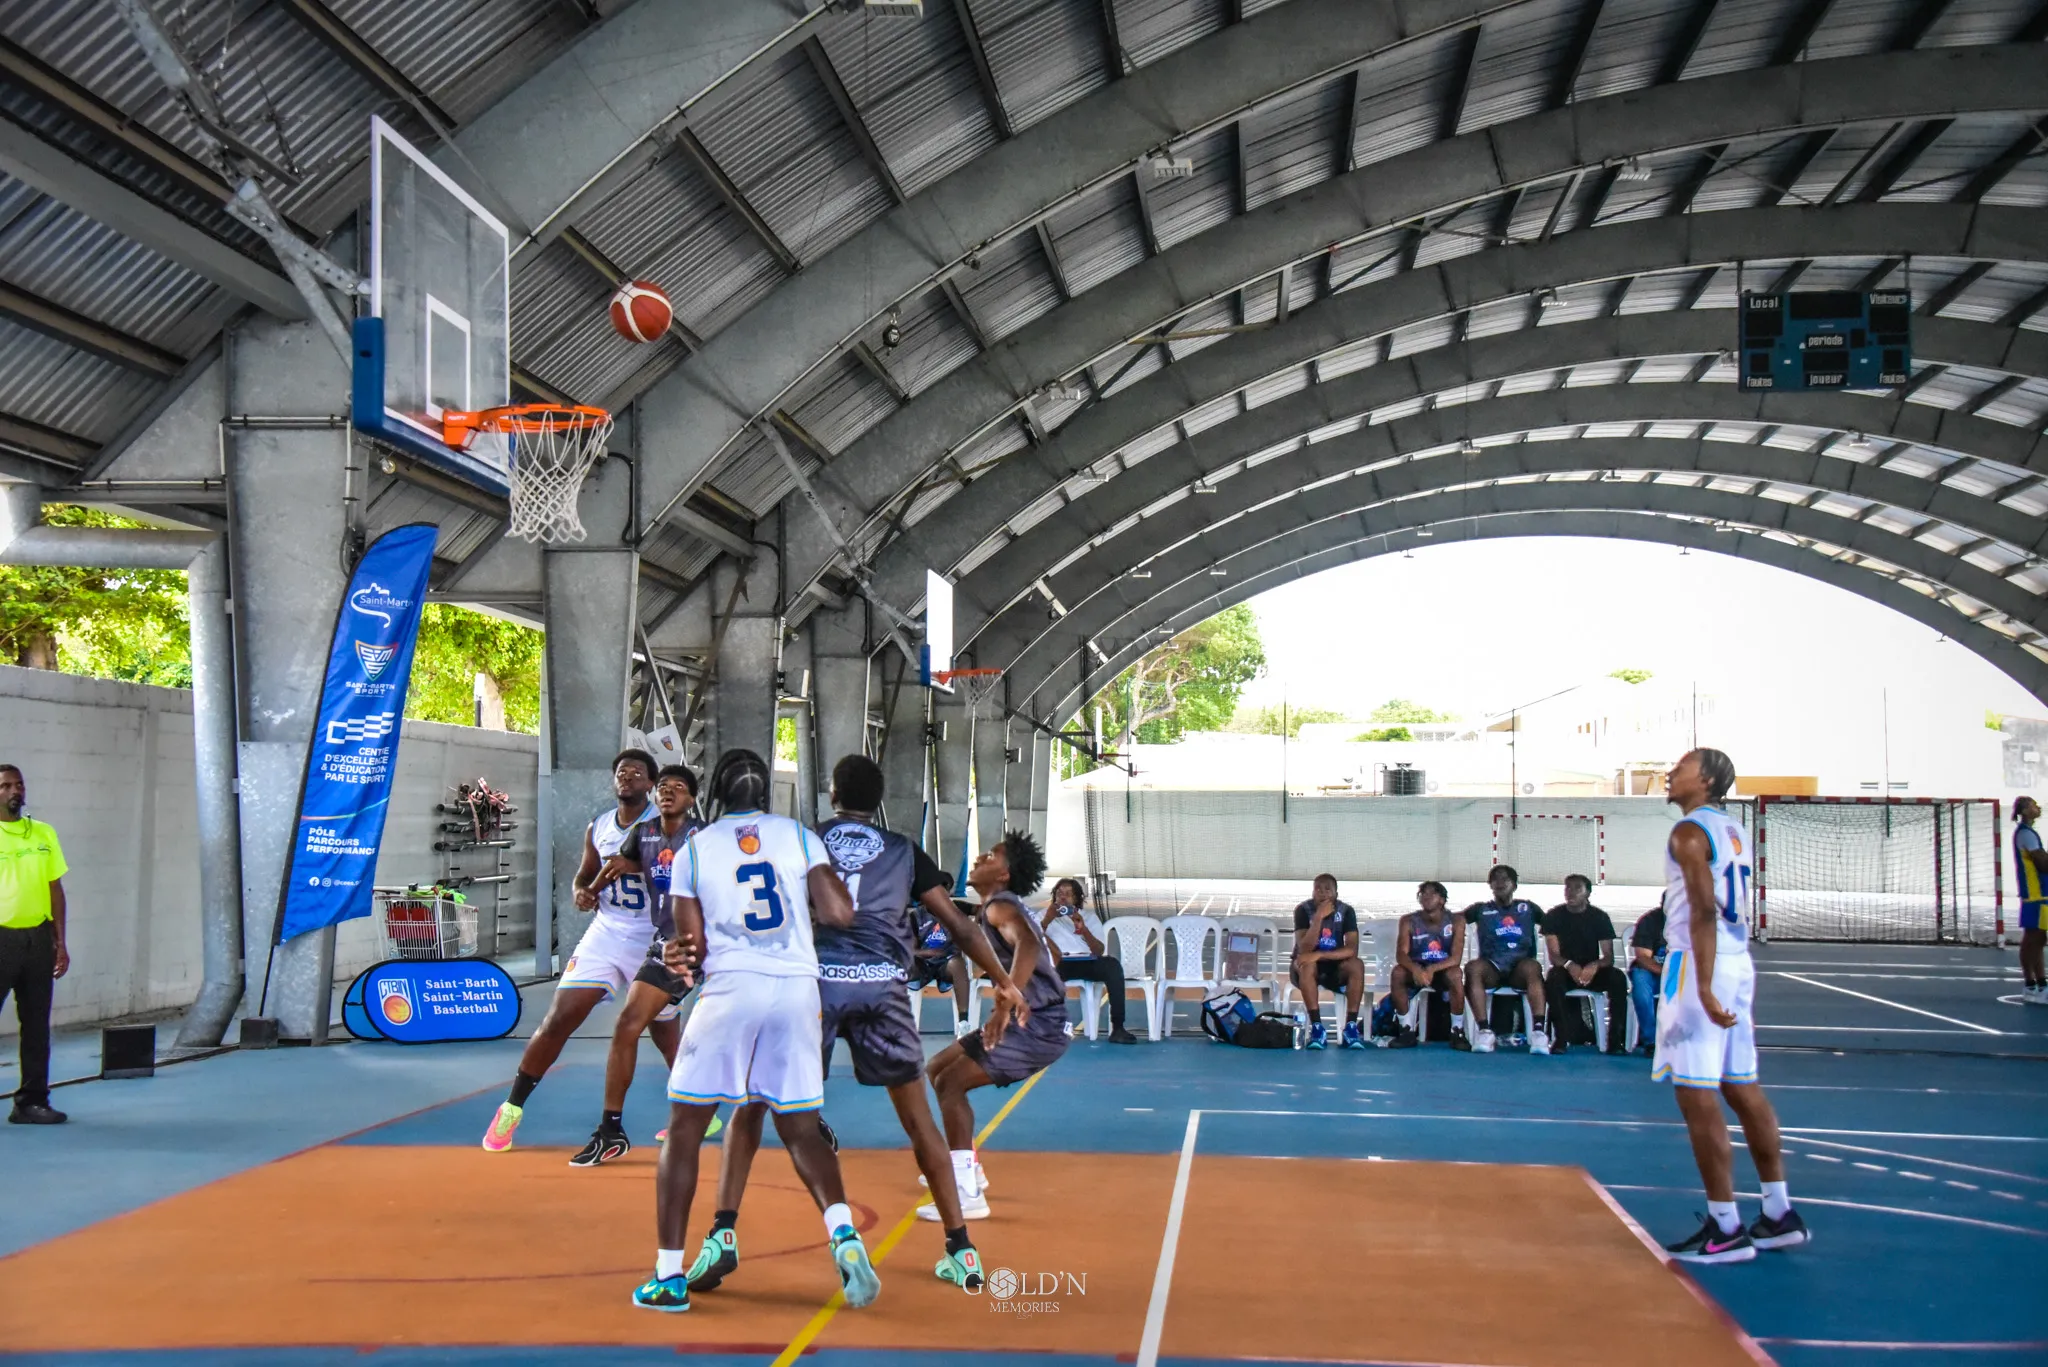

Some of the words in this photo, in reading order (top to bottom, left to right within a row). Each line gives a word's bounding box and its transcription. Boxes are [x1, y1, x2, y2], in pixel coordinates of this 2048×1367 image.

[1750, 297, 1778, 309] Local
[1746, 377, 1773, 388] fautes
[1809, 373, 1843, 386] joueur
[1879, 373, 1906, 384] fautes
[360, 595, 413, 607] Saint-Martn
[358, 747, 390, 756] CENTE
[321, 763, 327, 771] &
[330, 762, 386, 775] D'ÉDUCATON
[325, 773, 344, 782] PAR
[346, 775, 358, 783] LE
[309, 826, 336, 837] PÔLE
[307, 836, 360, 846] PARCOURS
[610, 872, 645, 910] 15
[734, 860, 786, 933] 3
[425, 978, 500, 989] Saint-Barth
[423, 990, 503, 1002] Saint-Martin
[433, 1003, 498, 1015] Basketball
